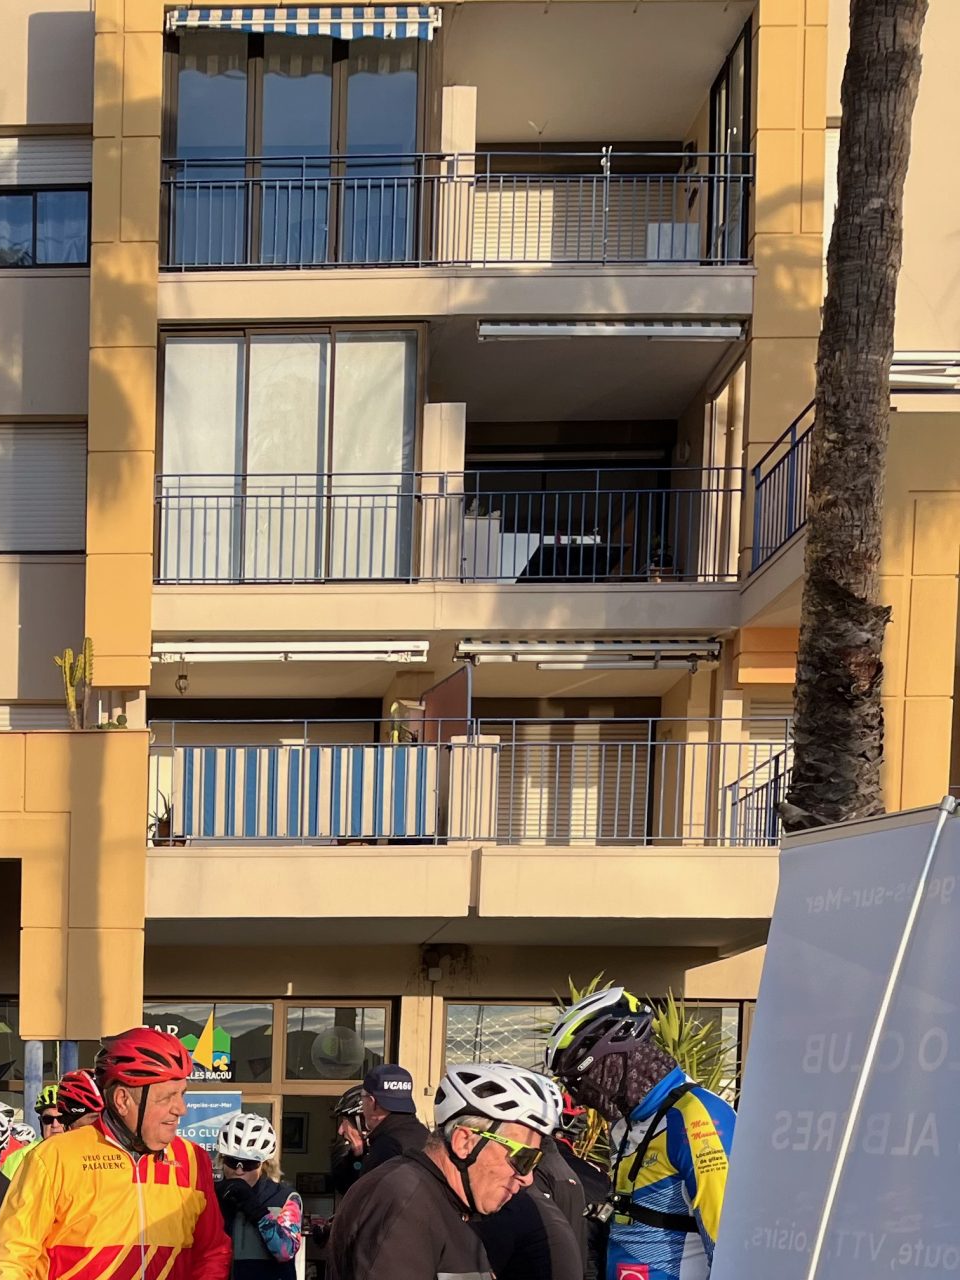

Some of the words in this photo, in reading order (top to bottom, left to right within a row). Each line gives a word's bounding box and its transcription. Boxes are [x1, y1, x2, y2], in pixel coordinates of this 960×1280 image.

[186, 1071, 204, 1079] LES
[205, 1071, 231, 1079] RACOU
[383, 1081, 412, 1091] VCA66
[82, 1154, 101, 1162] VELO
[102, 1154, 122, 1162] CLUB
[82, 1162, 126, 1171] PALAUENC
